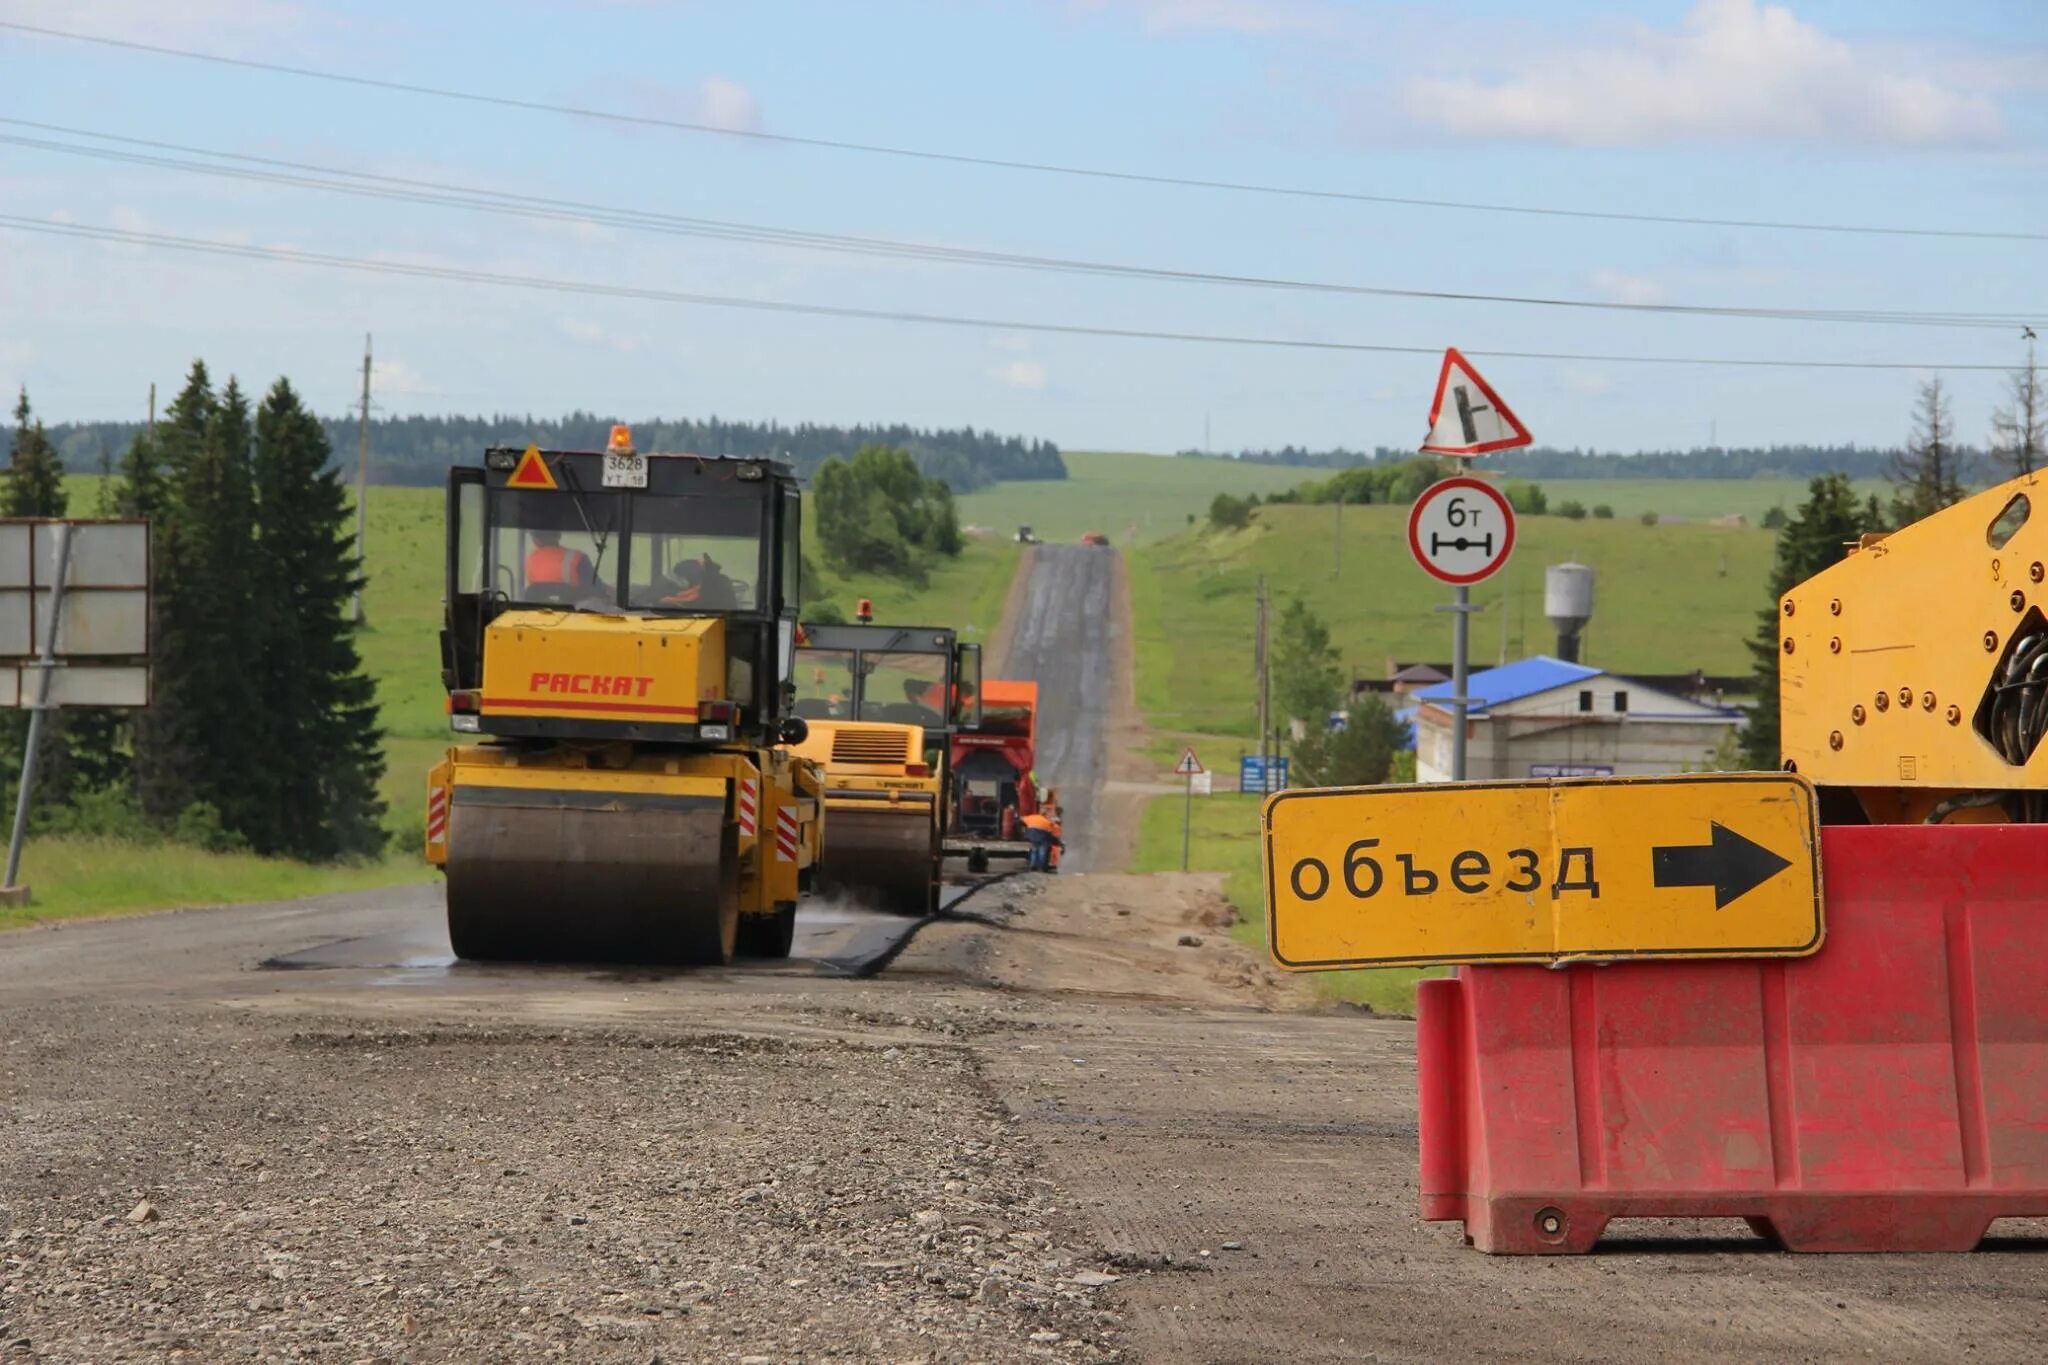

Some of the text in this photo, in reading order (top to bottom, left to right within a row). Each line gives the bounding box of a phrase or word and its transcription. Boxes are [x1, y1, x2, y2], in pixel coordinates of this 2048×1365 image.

[608, 457, 643, 471] 3628
[529, 672, 655, 697] РАСКАТ
[1290, 838, 1599, 902] объезд
